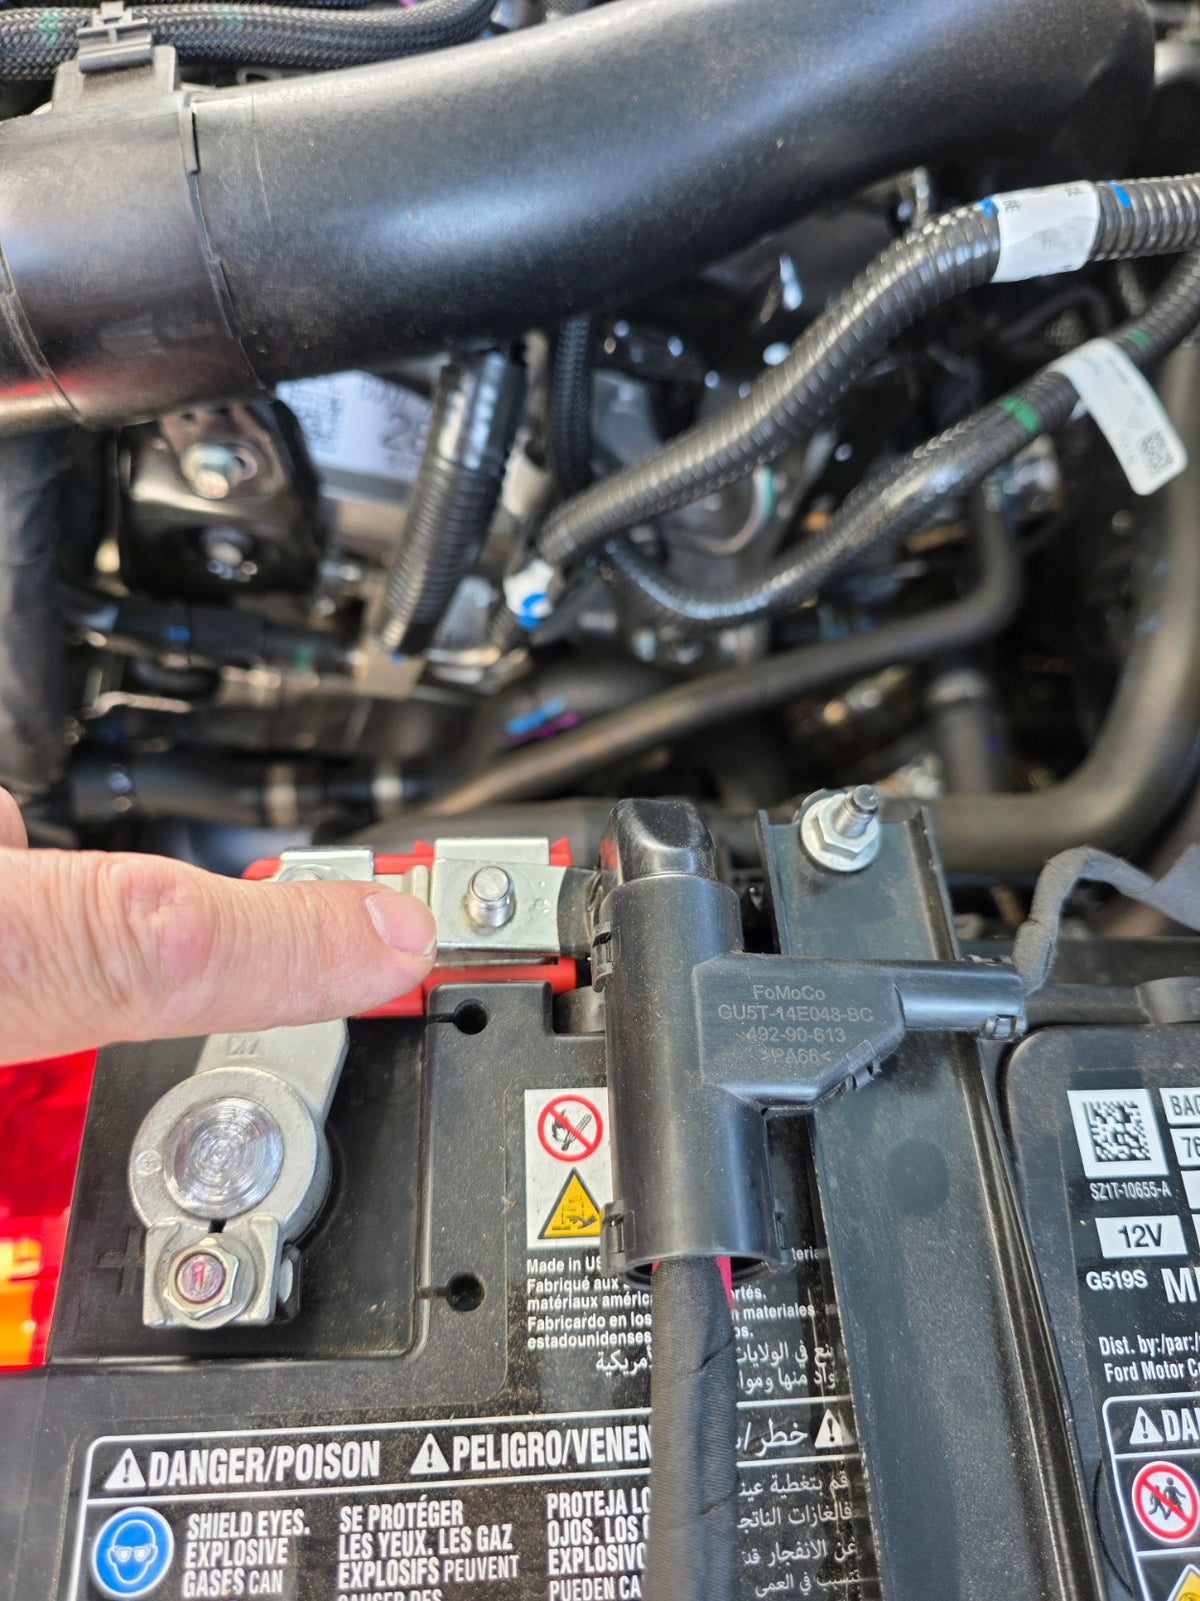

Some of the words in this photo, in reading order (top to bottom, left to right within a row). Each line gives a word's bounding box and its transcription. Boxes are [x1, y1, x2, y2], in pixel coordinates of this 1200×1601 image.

[753, 984, 826, 1001] FoMoCo
[717, 1003, 874, 1022] GU5T-14E048-BC
[747, 1026, 846, 1043] 492-90-613
[1089, 1180, 1173, 1201] SZ1T-10655-A
[1117, 1223, 1162, 1249] 12V
[526, 1257, 565, 1274] Made
[568, 1256, 582, 1273] in
[526, 1276, 591, 1295] Fabriqué
[593, 1277, 620, 1291] aux
[1085, 1269, 1149, 1292] G519S
[527, 1294, 599, 1312] matériaux
[602, 1290, 653, 1309] améric
[527, 1314, 606, 1333] Fabricardo
[609, 1314, 627, 1328] en
[630, 1311, 653, 1328] los
[743, 1303, 816, 1320] materiales
[527, 1330, 653, 1350] estadounidenses
[1098, 1335, 1136, 1357] Dist.
[1137, 1331, 1200, 1358] by:/par:/
[794, 1340, 809, 1367] في
[777, 1367, 808, 1391] منها
[1104, 1361, 1139, 1384] Ford
[1140, 1359, 1185, 1381] Motor
[149, 1440, 381, 1488] DANGER/POISON
[770, 1473, 824, 1500] بتغطية
[829, 1470, 851, 1492] قم
[339, 1504, 363, 1533] SE
[368, 1494, 464, 1531] PROTÉGER
[547, 1488, 628, 1519] PROTEJA
[187, 1512, 251, 1540] SHIELD
[257, 1508, 311, 1537] EYES.
[547, 1518, 600, 1548] OJOS.
[604, 1514, 639, 1544] LOS
[183, 1537, 289, 1569] EXPLOSIVE
[338, 1532, 374, 1561] LES
[377, 1529, 434, 1558] YEUX.
[437, 1526, 472, 1555] LES
[476, 1523, 514, 1552] GAZ
[768, 1538, 828, 1567] الانفجار
[182, 1567, 245, 1598] GASES
[249, 1569, 284, 1594] CAN
[337, 1556, 440, 1589] EXPLOSIFS
[443, 1554, 520, 1583] PEUVENT
[800, 1570, 811, 1595] في
[549, 1577, 616, 1601] PUEDEN
[619, 1574, 644, 1600] CA
[754, 1573, 795, 1598] العمى
